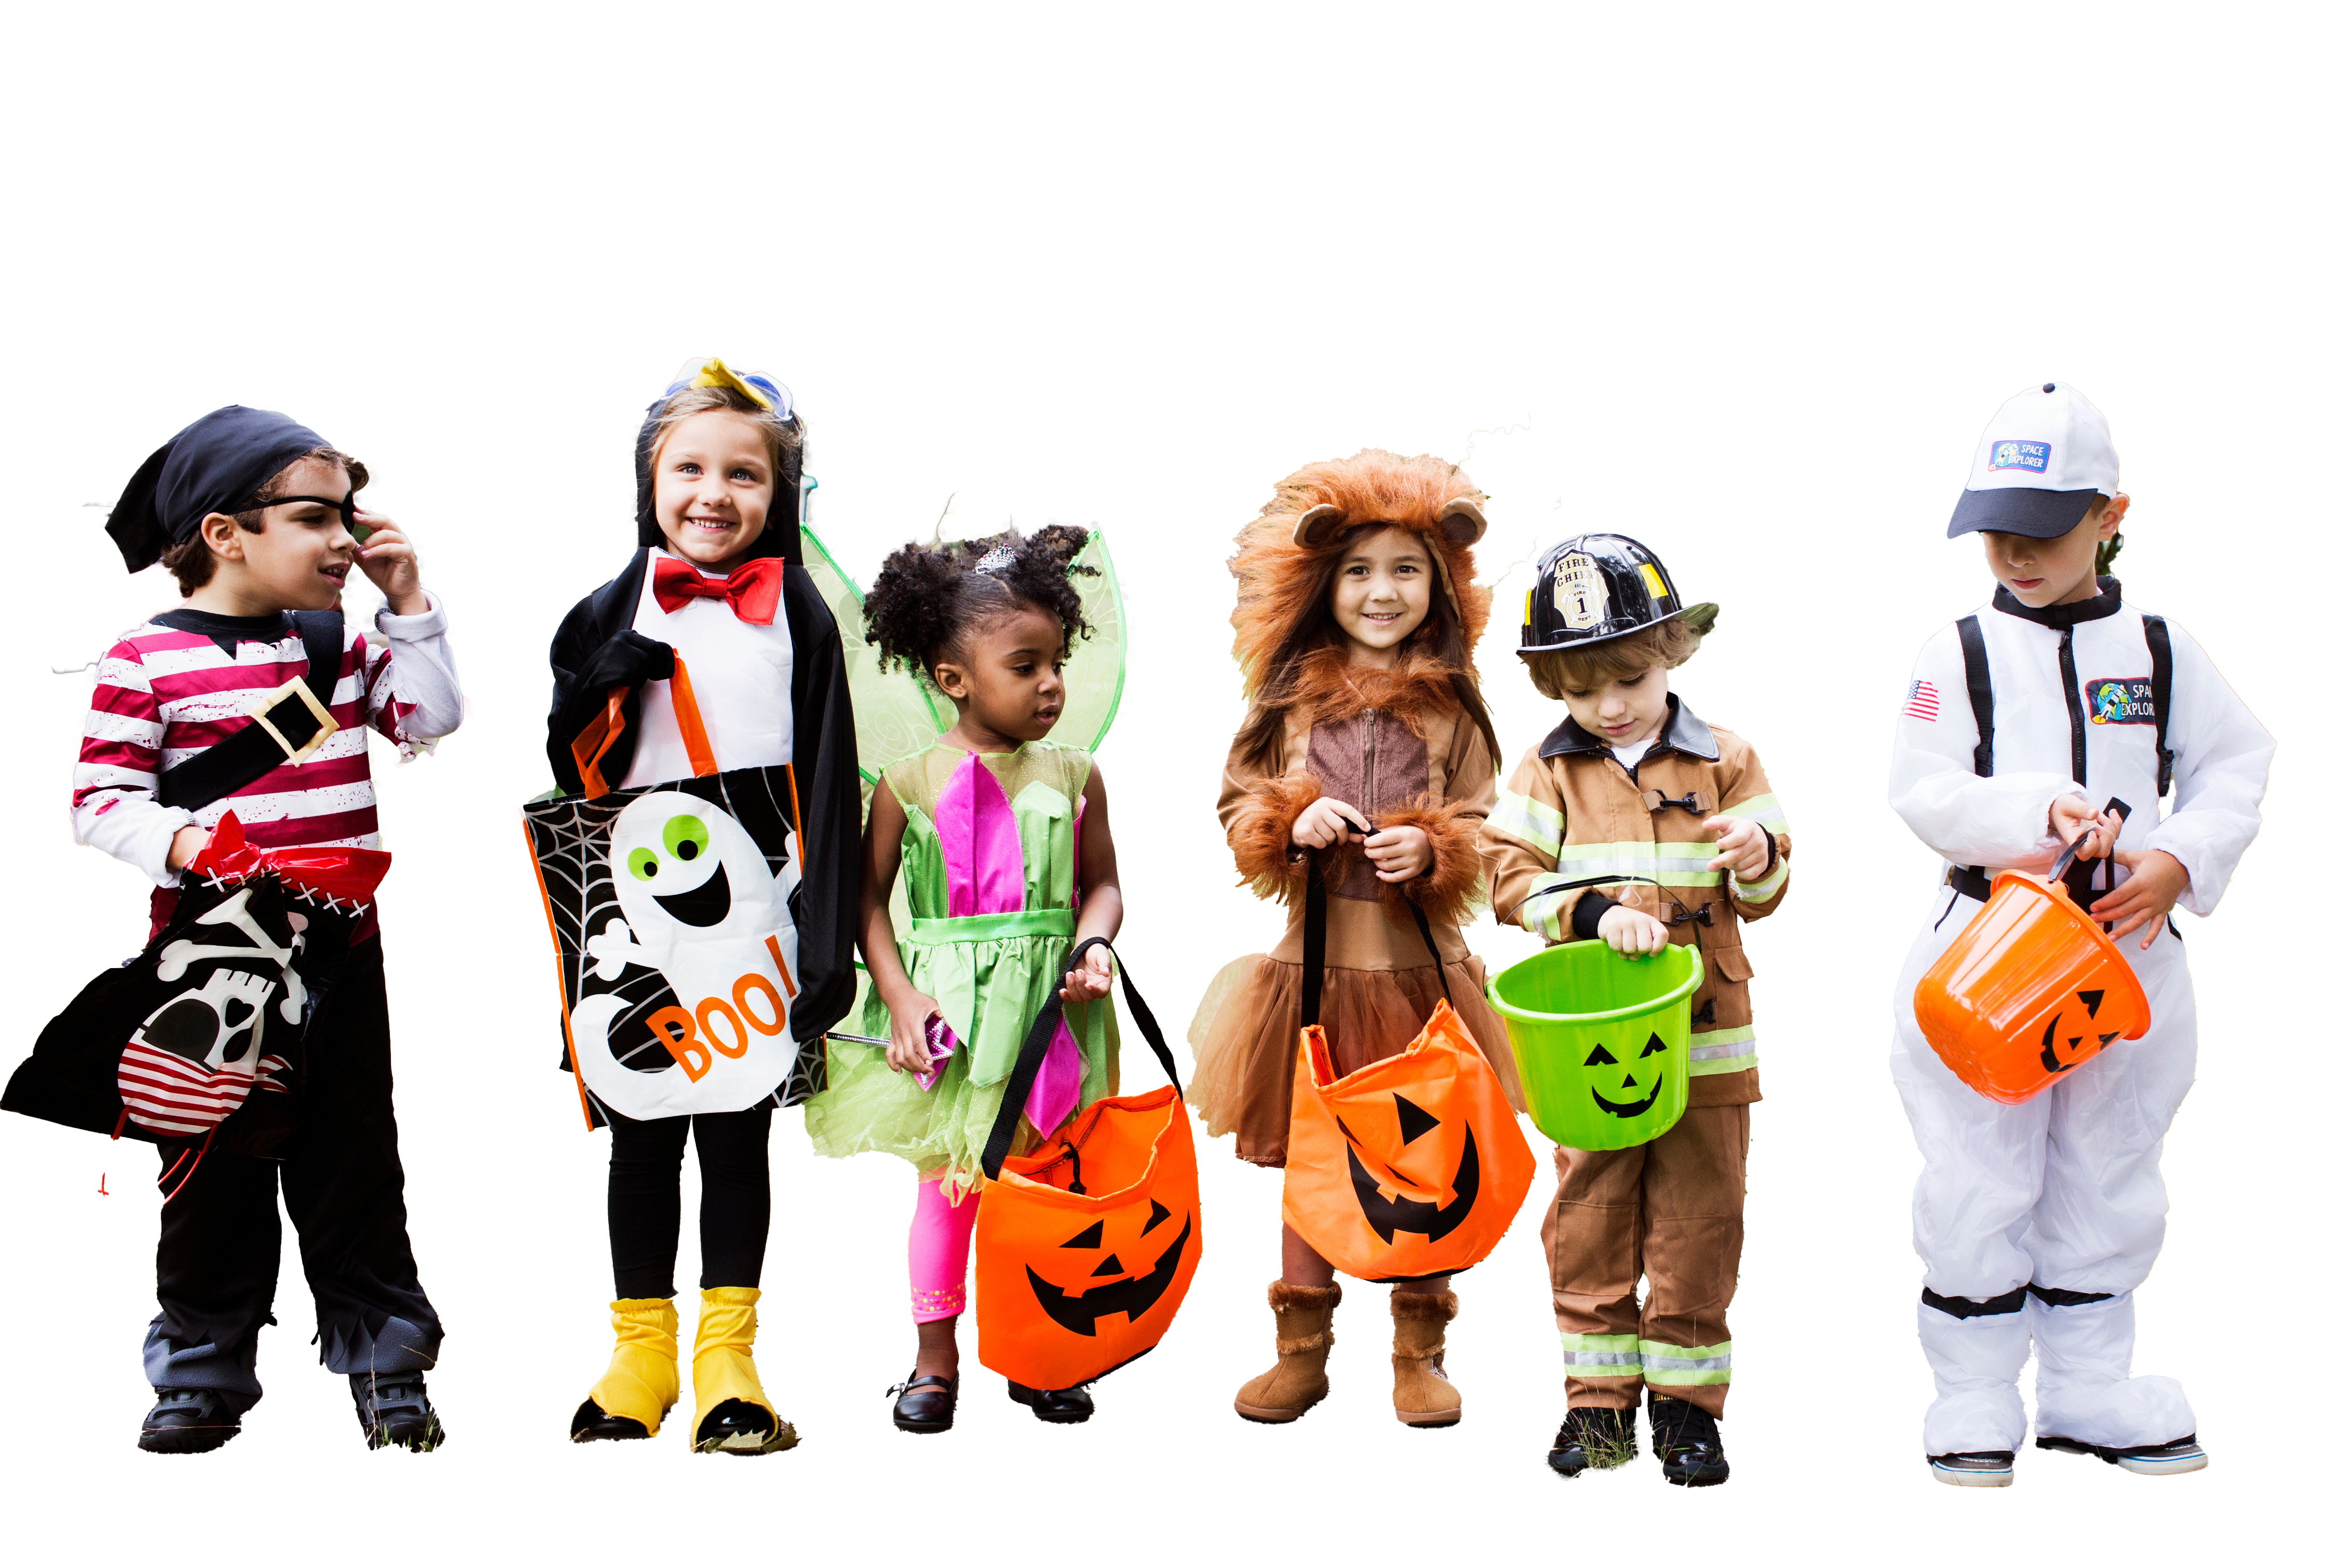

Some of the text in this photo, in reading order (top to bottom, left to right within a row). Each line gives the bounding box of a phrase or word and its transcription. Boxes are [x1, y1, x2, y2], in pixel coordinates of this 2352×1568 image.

[2021, 444, 2044, 456] SPACE
[2008, 455, 2043, 468] EXPLORER
[1558, 558, 1588, 573] FIRE
[1577, 597, 1587, 614] 1
[2121, 702, 2155, 716] EXPLOR
[645, 934, 797, 1083] BOO!
